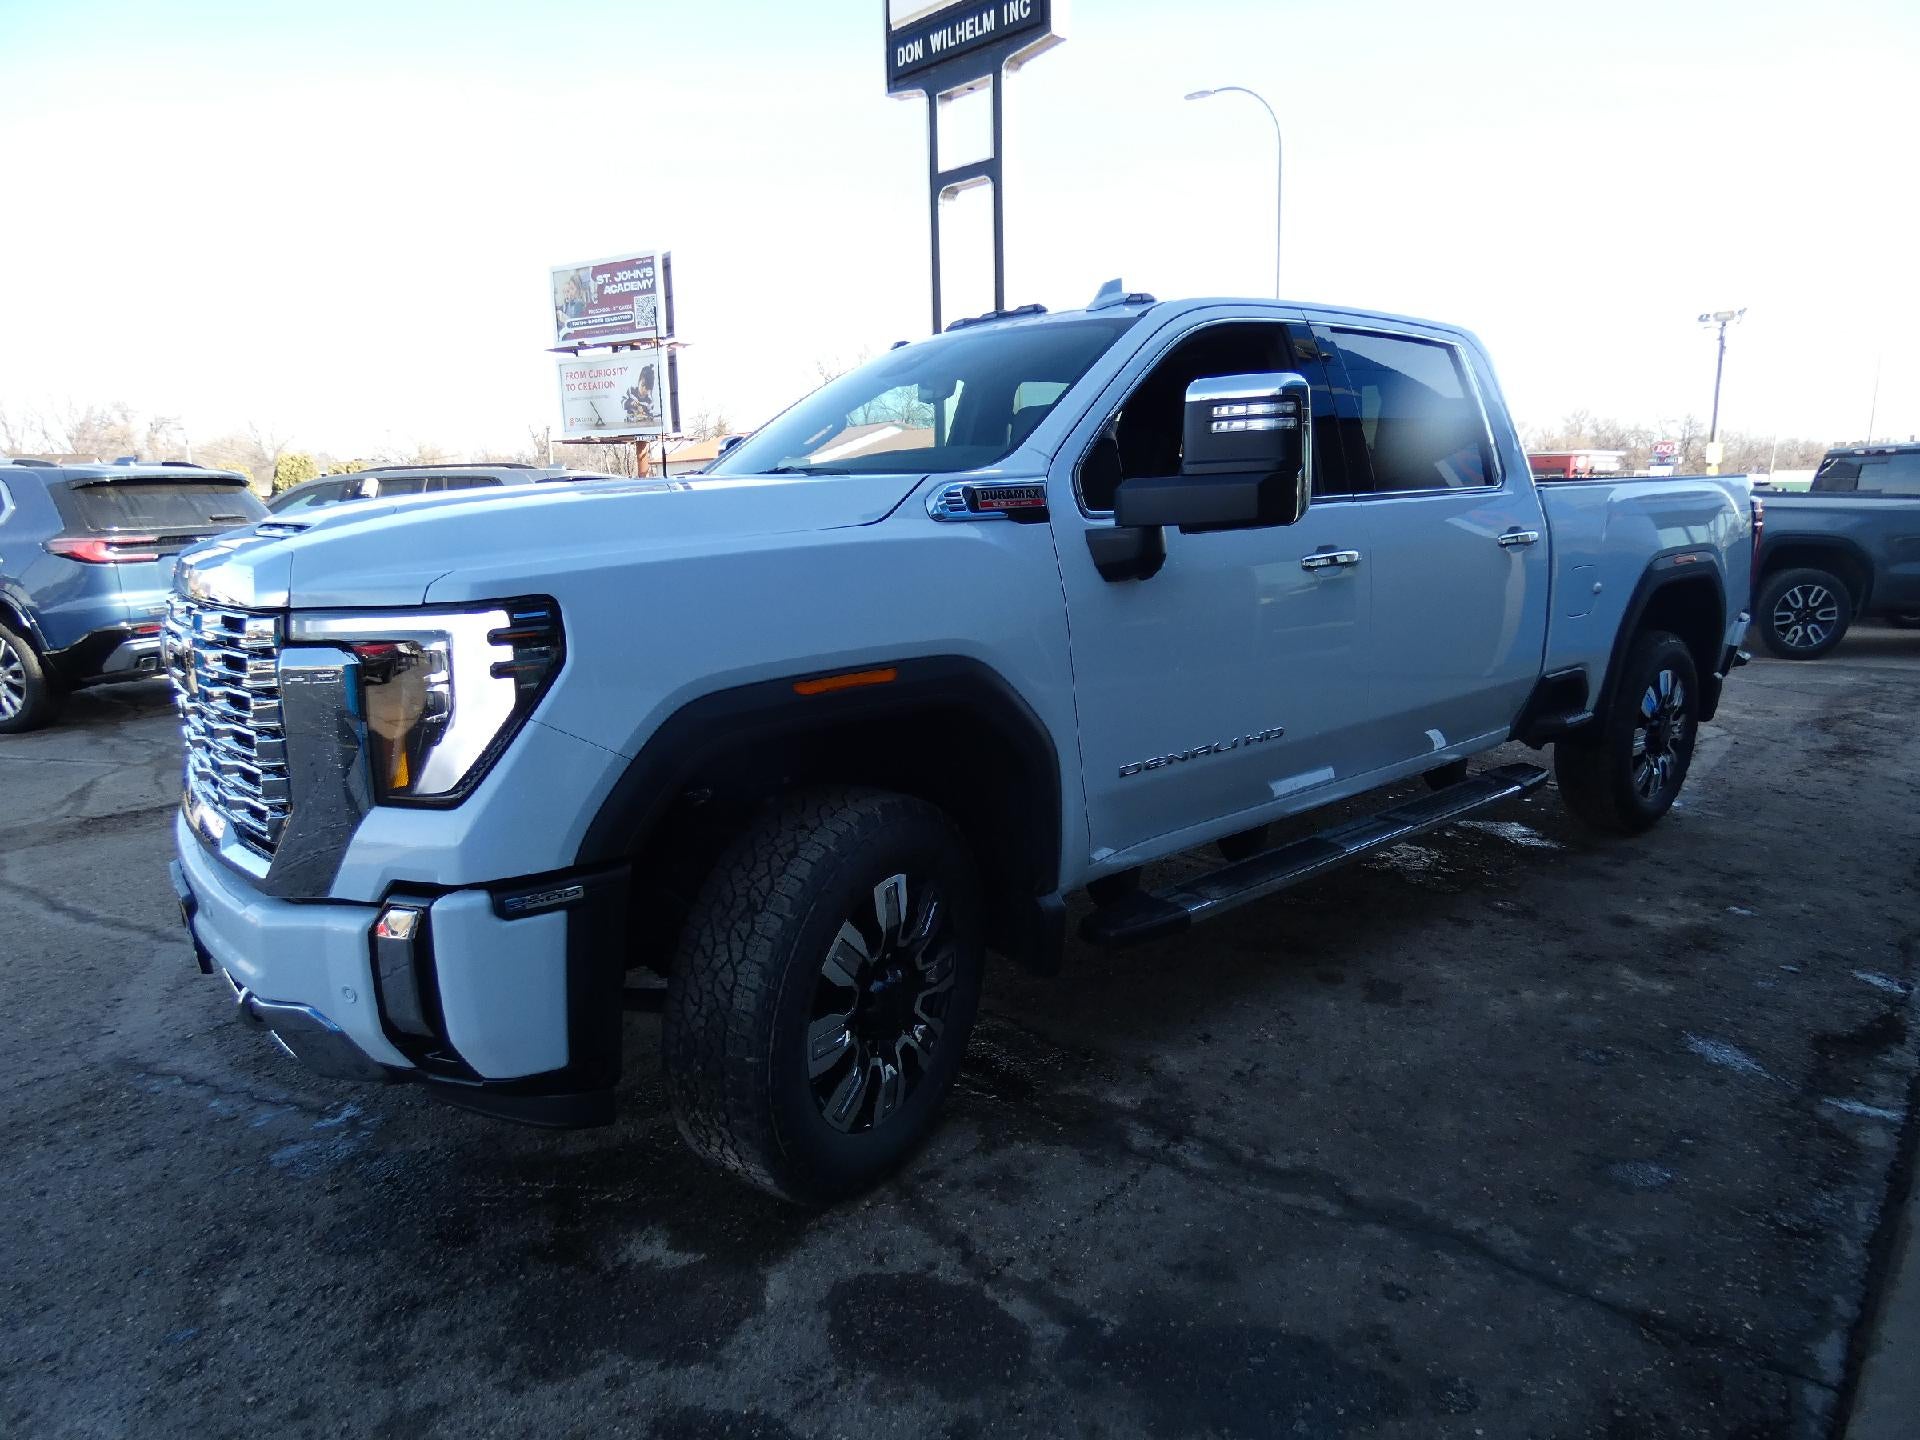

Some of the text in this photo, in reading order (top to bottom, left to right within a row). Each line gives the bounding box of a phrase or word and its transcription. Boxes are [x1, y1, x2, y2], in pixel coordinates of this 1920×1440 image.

[897, 0, 1031, 67] DON WILHELM INC
[596, 267, 654, 285] ST. JOHN'S
[603, 278, 654, 295] ACADEMY
[565, 366, 629, 381] FROM CURIOSITY
[566, 380, 615, 392] TO CREATION
[981, 488, 1041, 500] DURAMAX
[1119, 726, 1286, 778] DENALI HD
